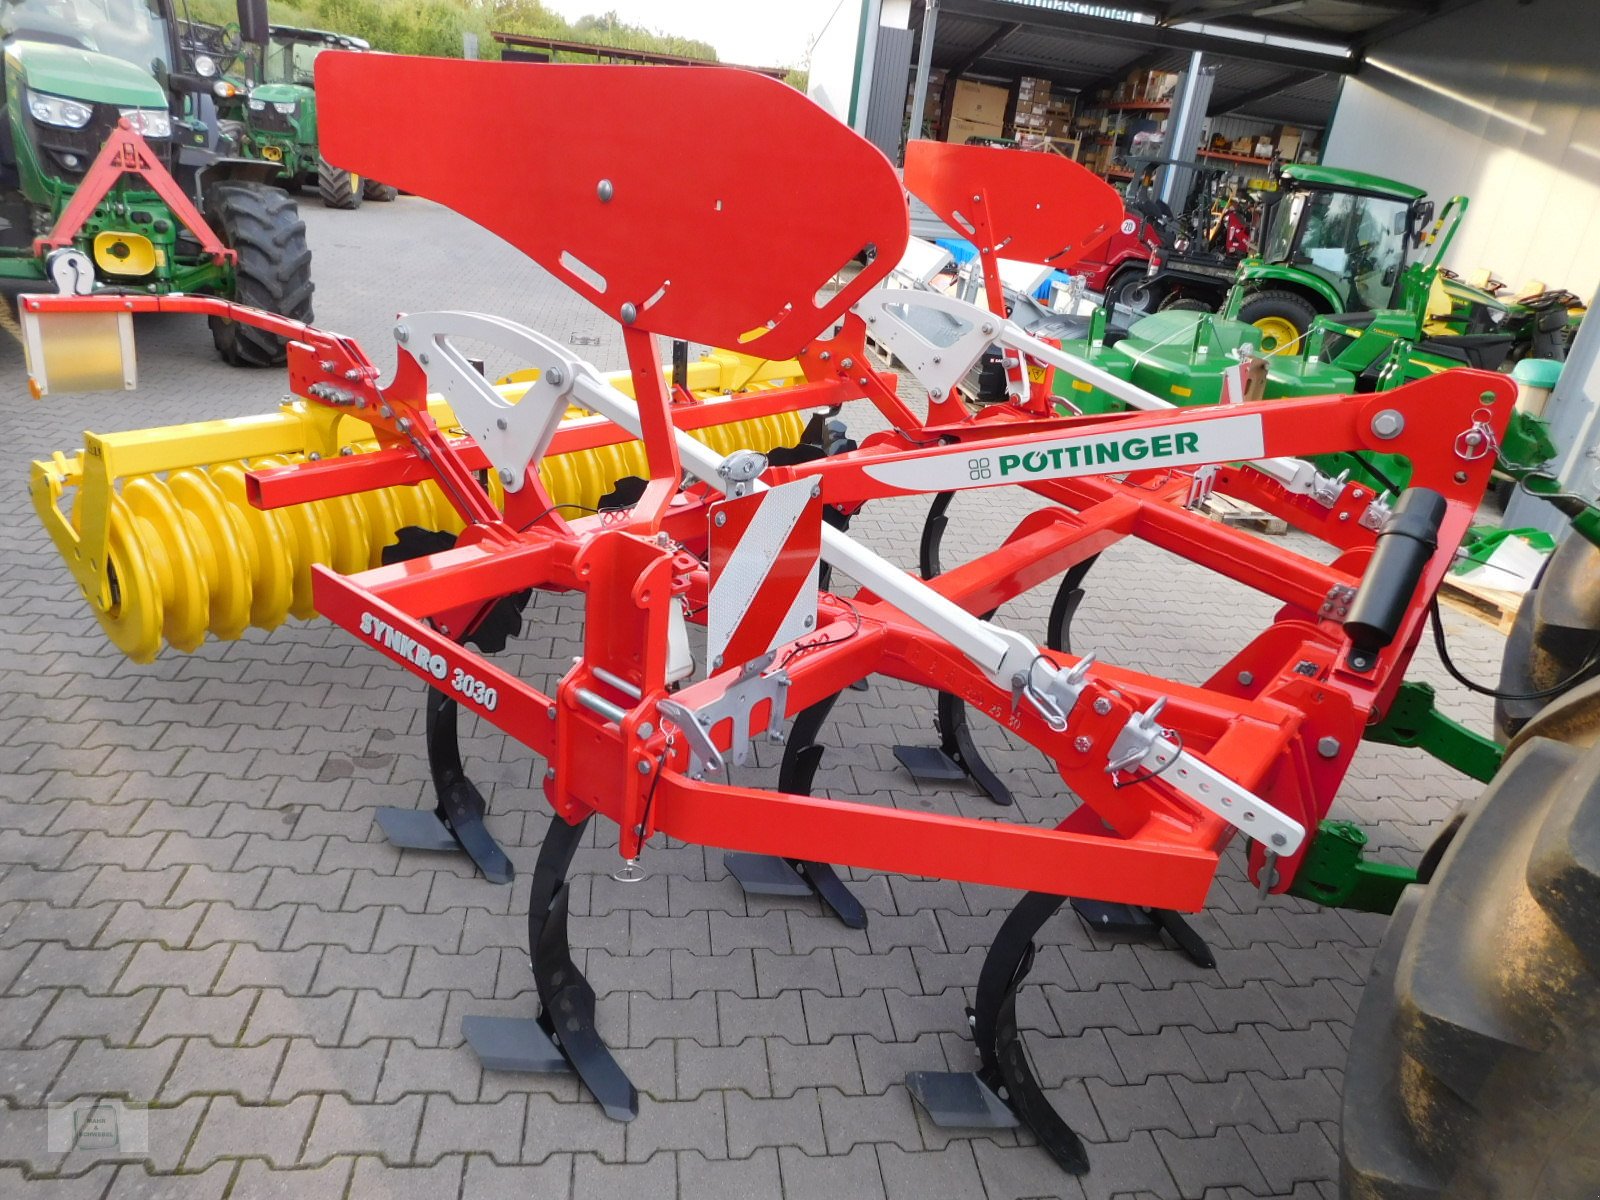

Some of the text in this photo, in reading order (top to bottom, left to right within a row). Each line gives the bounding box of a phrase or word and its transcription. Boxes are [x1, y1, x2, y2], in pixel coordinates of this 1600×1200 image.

[1123, 221, 1134, 232] 20
[999, 431, 1199, 476] PÖTTINGER
[359, 611, 497, 711] SYNKRO 3030
